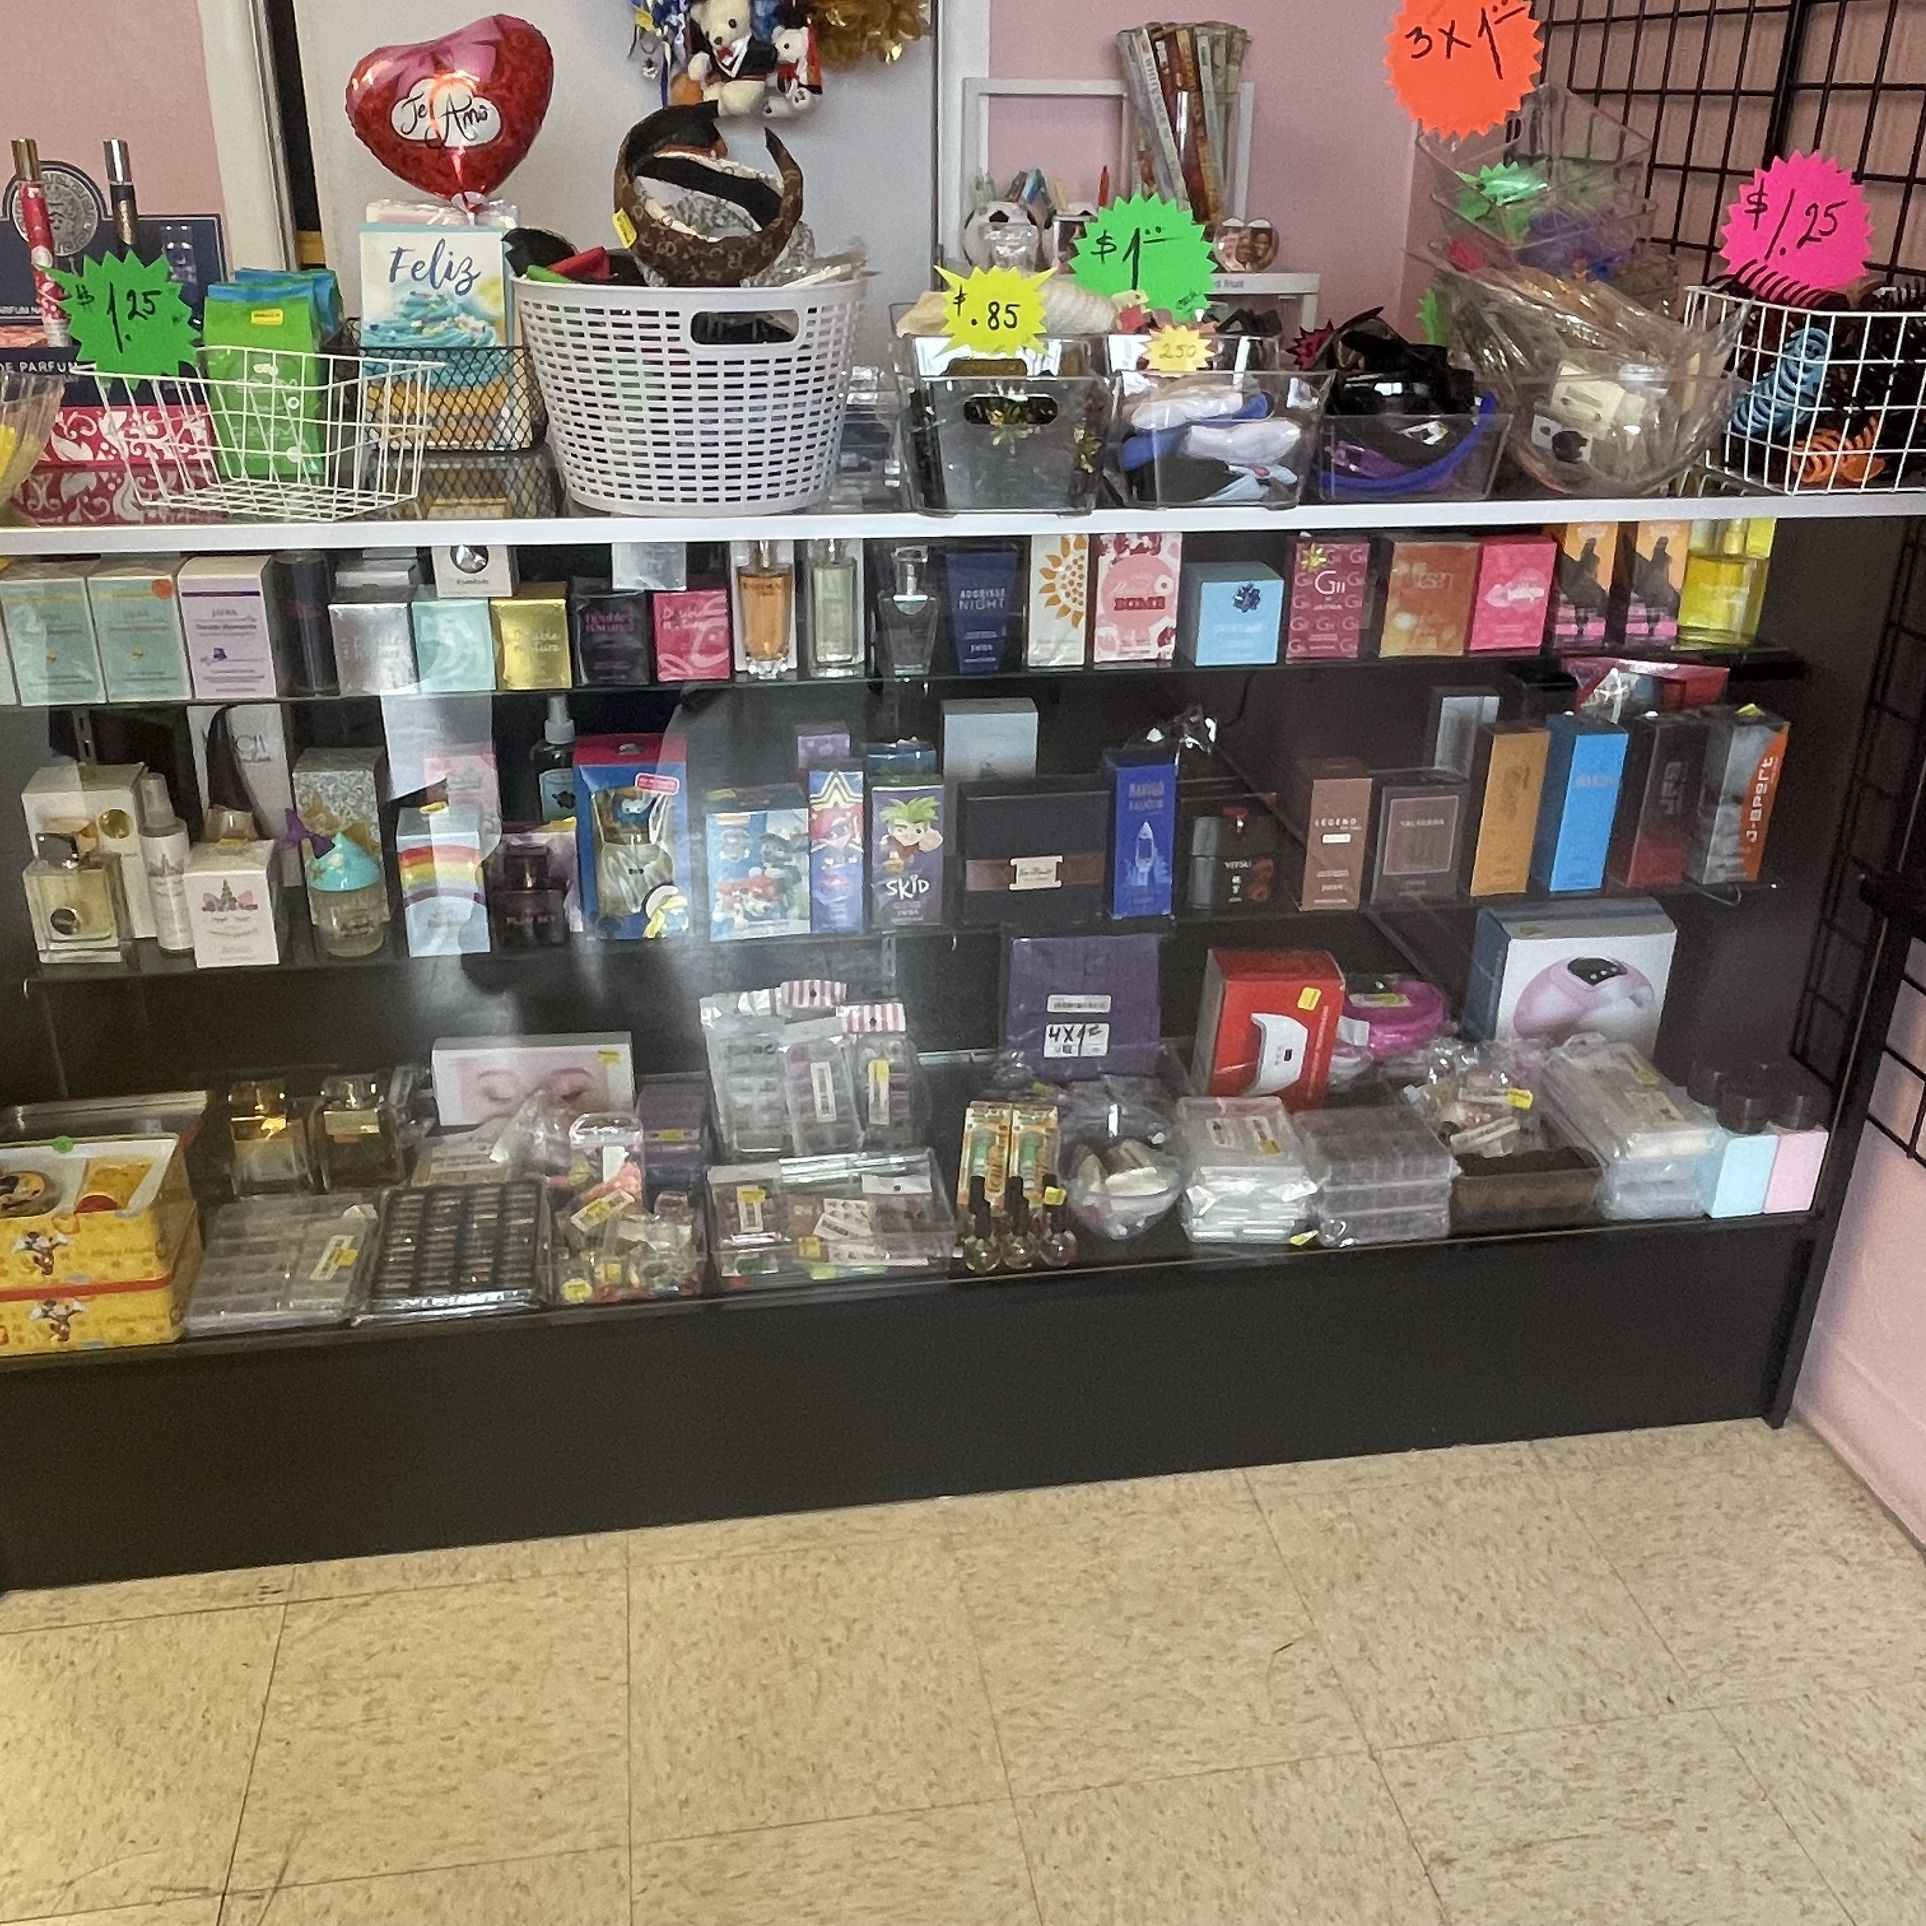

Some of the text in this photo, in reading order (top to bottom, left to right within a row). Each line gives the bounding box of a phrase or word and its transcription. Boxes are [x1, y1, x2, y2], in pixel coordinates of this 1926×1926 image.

[388, 238, 481, 297] Feliz
[959, 599, 1005, 611] NIGHT
[1314, 817, 1357, 828] LEGEND
[886, 874, 930, 900] SKID
